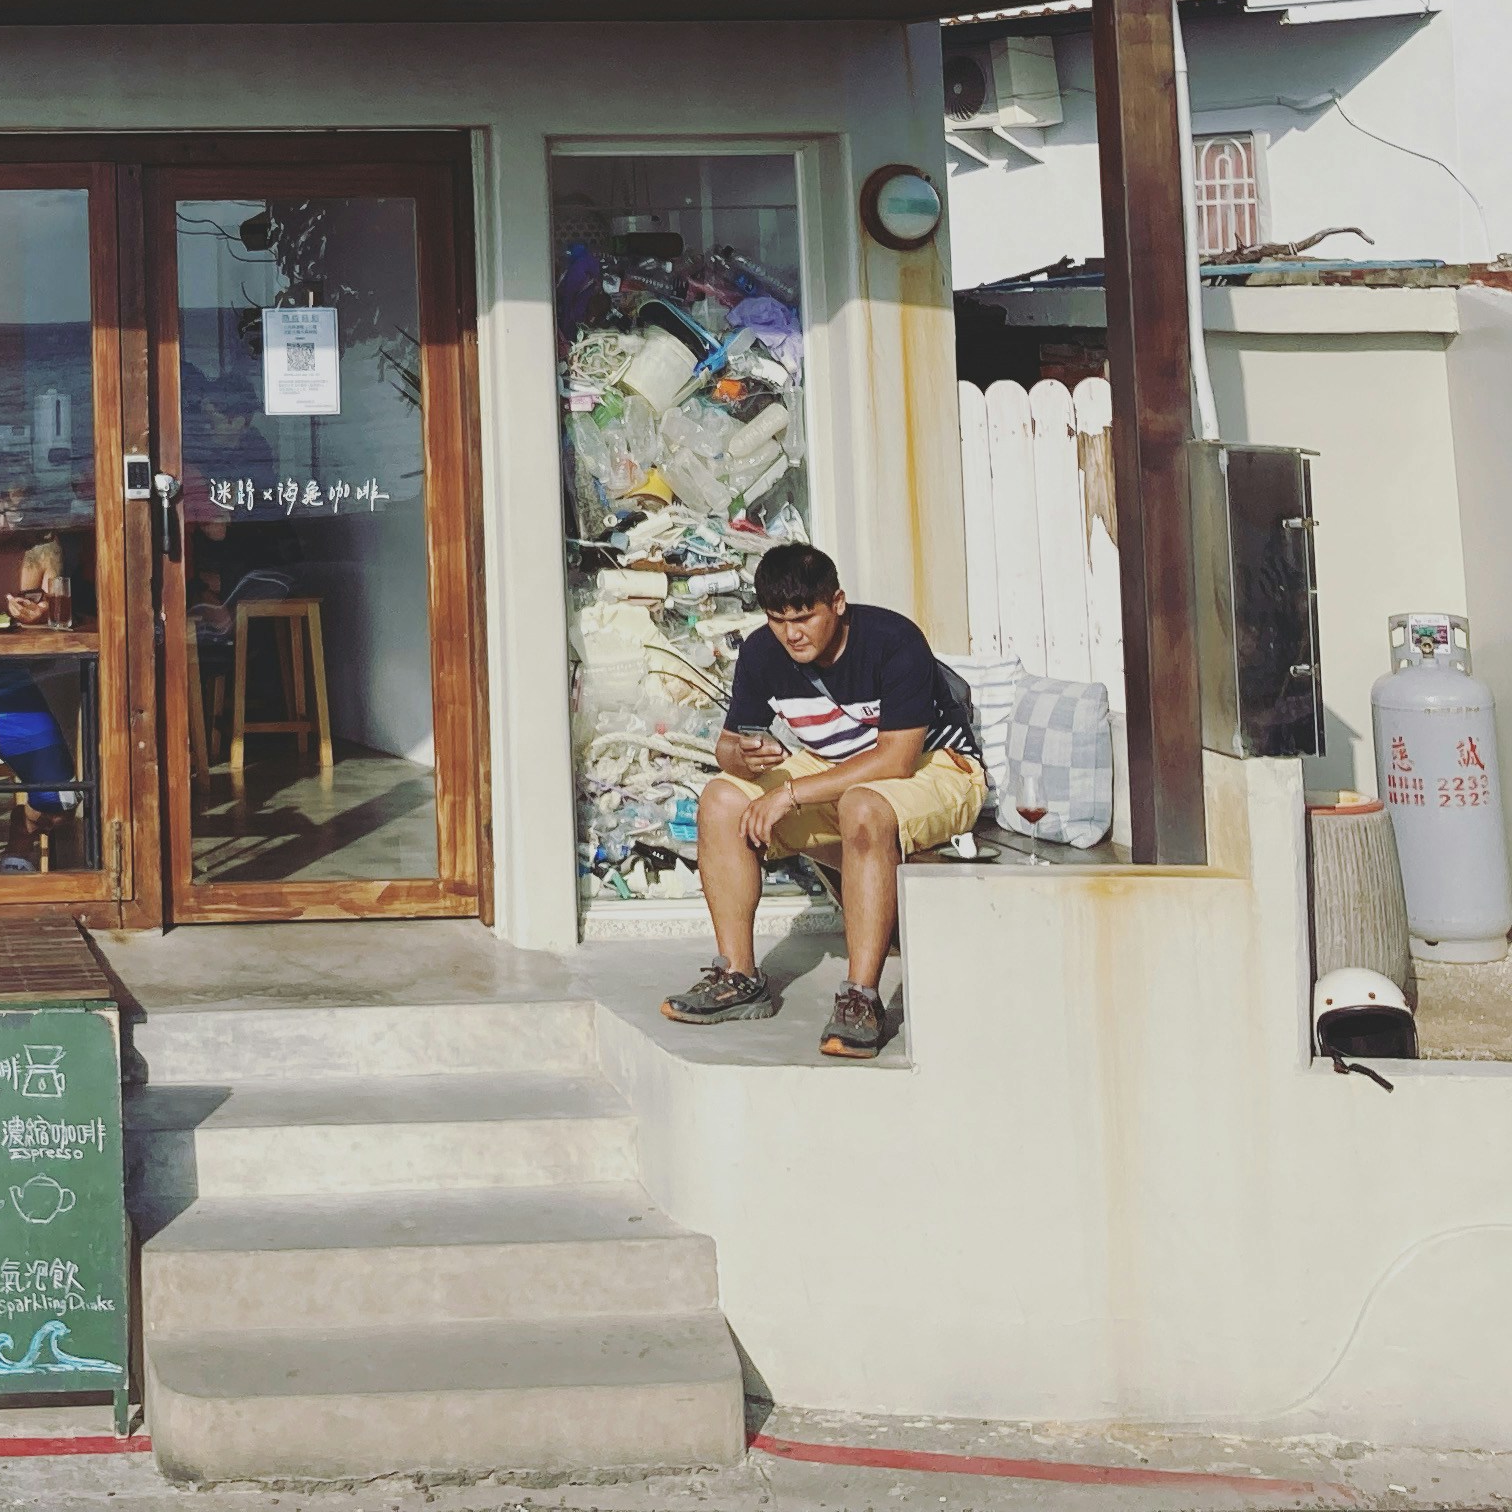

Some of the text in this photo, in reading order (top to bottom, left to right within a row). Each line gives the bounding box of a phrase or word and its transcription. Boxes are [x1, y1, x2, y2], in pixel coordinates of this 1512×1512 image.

[0, 1114, 107, 1153] 濃縮咖啡
[8, 1147, 85, 1163] Espresso
